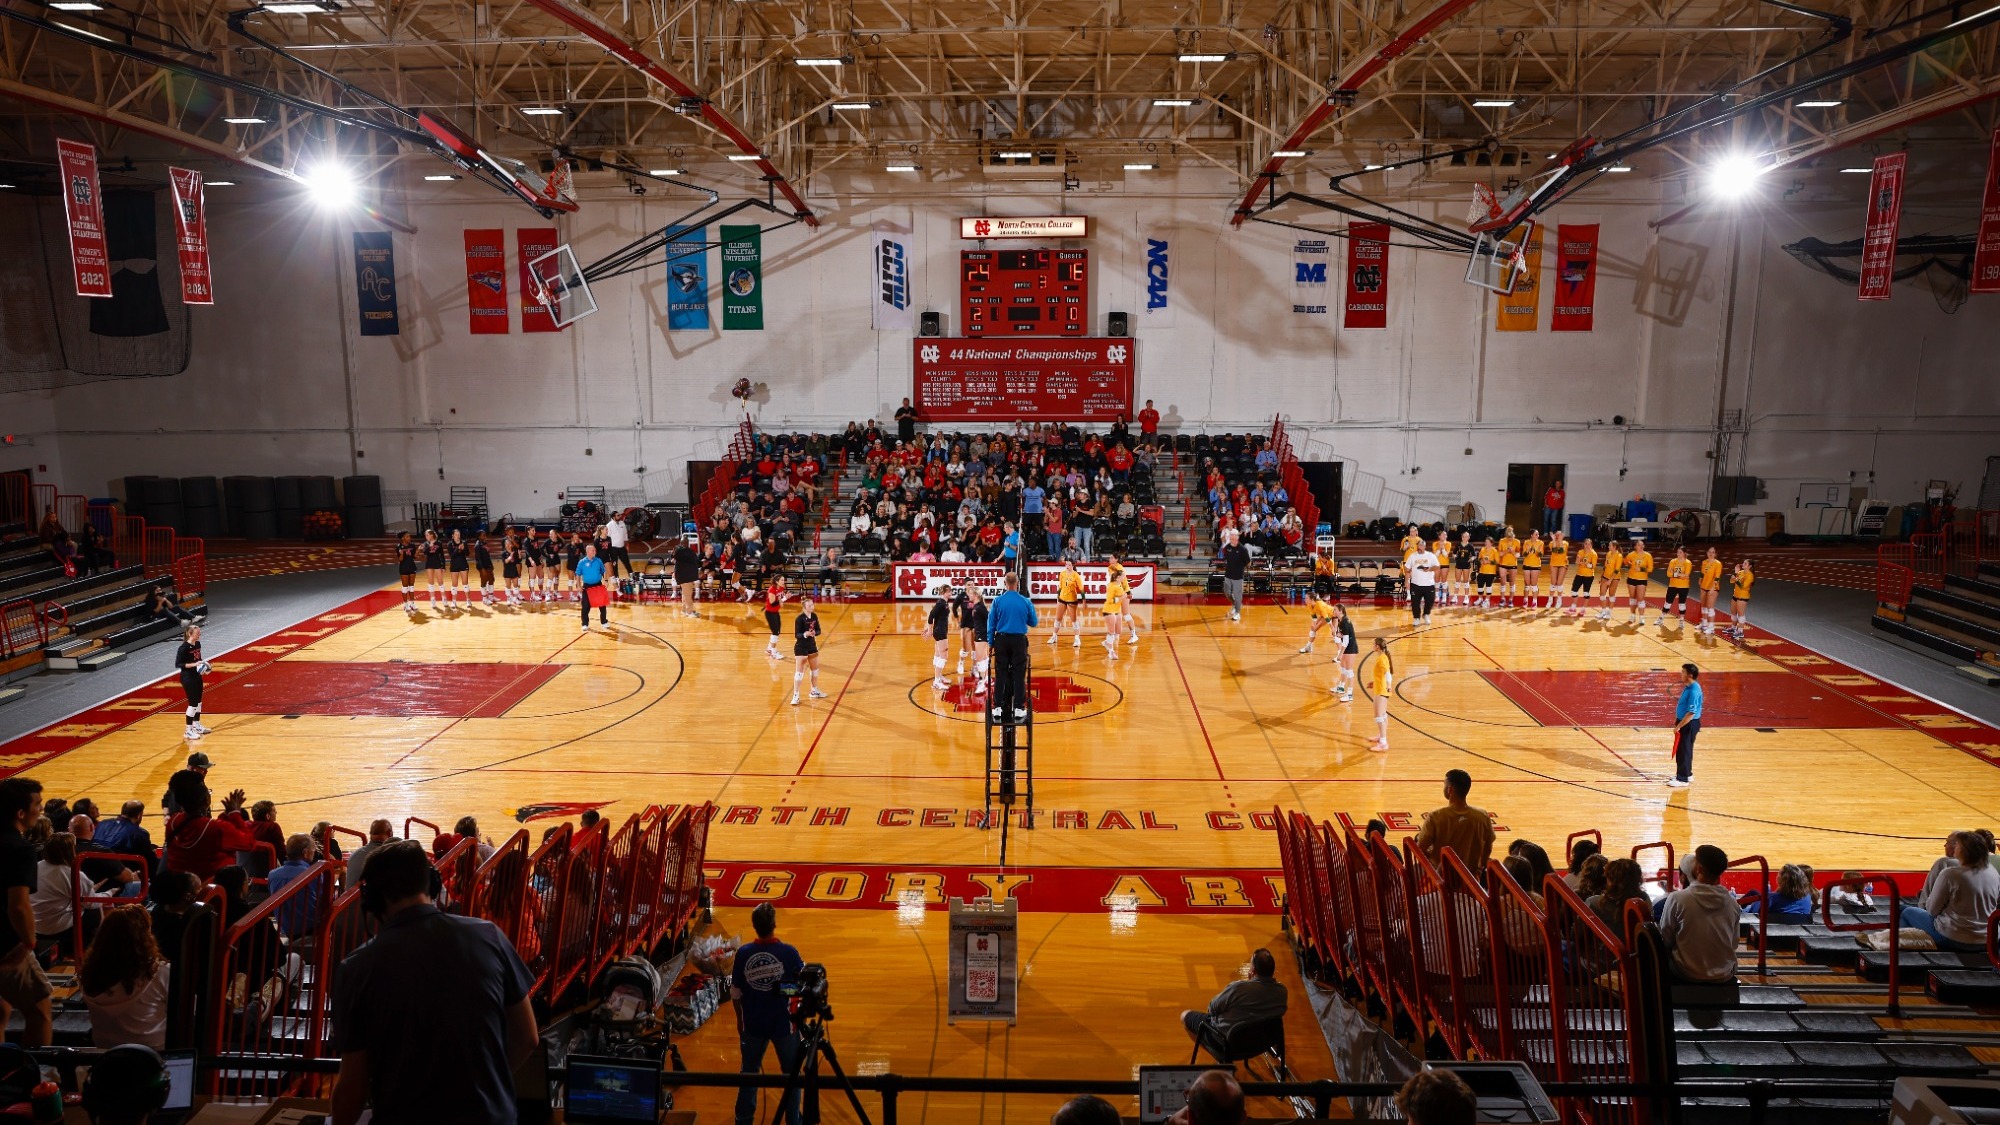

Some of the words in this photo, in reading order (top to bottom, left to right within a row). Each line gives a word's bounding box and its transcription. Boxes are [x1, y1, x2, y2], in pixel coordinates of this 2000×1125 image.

[997, 220, 1019, 229] NORTH
[1019, 220, 1047, 229] CENTRAL
[1047, 220, 1074, 228] COLLEGE
[1294, 246, 1330, 254] UNIVERSITY
[723, 254, 759, 262] UNIVERSITY
[1147, 238, 1168, 309] NCAA
[1296, 262, 1327, 283] M
[81, 272, 105, 286] 2023
[1040, 275, 1047, 289] 3
[1865, 275, 1885, 289] 1983
[186, 282, 208, 295] 2024
[728, 305, 757, 314] TITANS
[1293, 304, 1306, 313] BIG
[1306, 305, 1327, 314] BLUE
[1348, 303, 1385, 311] CARDINALS
[1504, 306, 1534, 315] VIKINGS
[1555, 307, 1592, 315] THUNDER
[471, 308, 506, 316] PIONEERS
[973, 307, 982, 321] 2
[1070, 307, 1078, 321] 0
[949, 349, 964, 360] 44
[965, 348, 1012, 359] National
[1015, 348, 1097, 362] Championships
[929, 569, 967, 578] NORTH
[1083, 572, 1107, 581] THE
[876, 807, 1178, 831] CENTRAL
